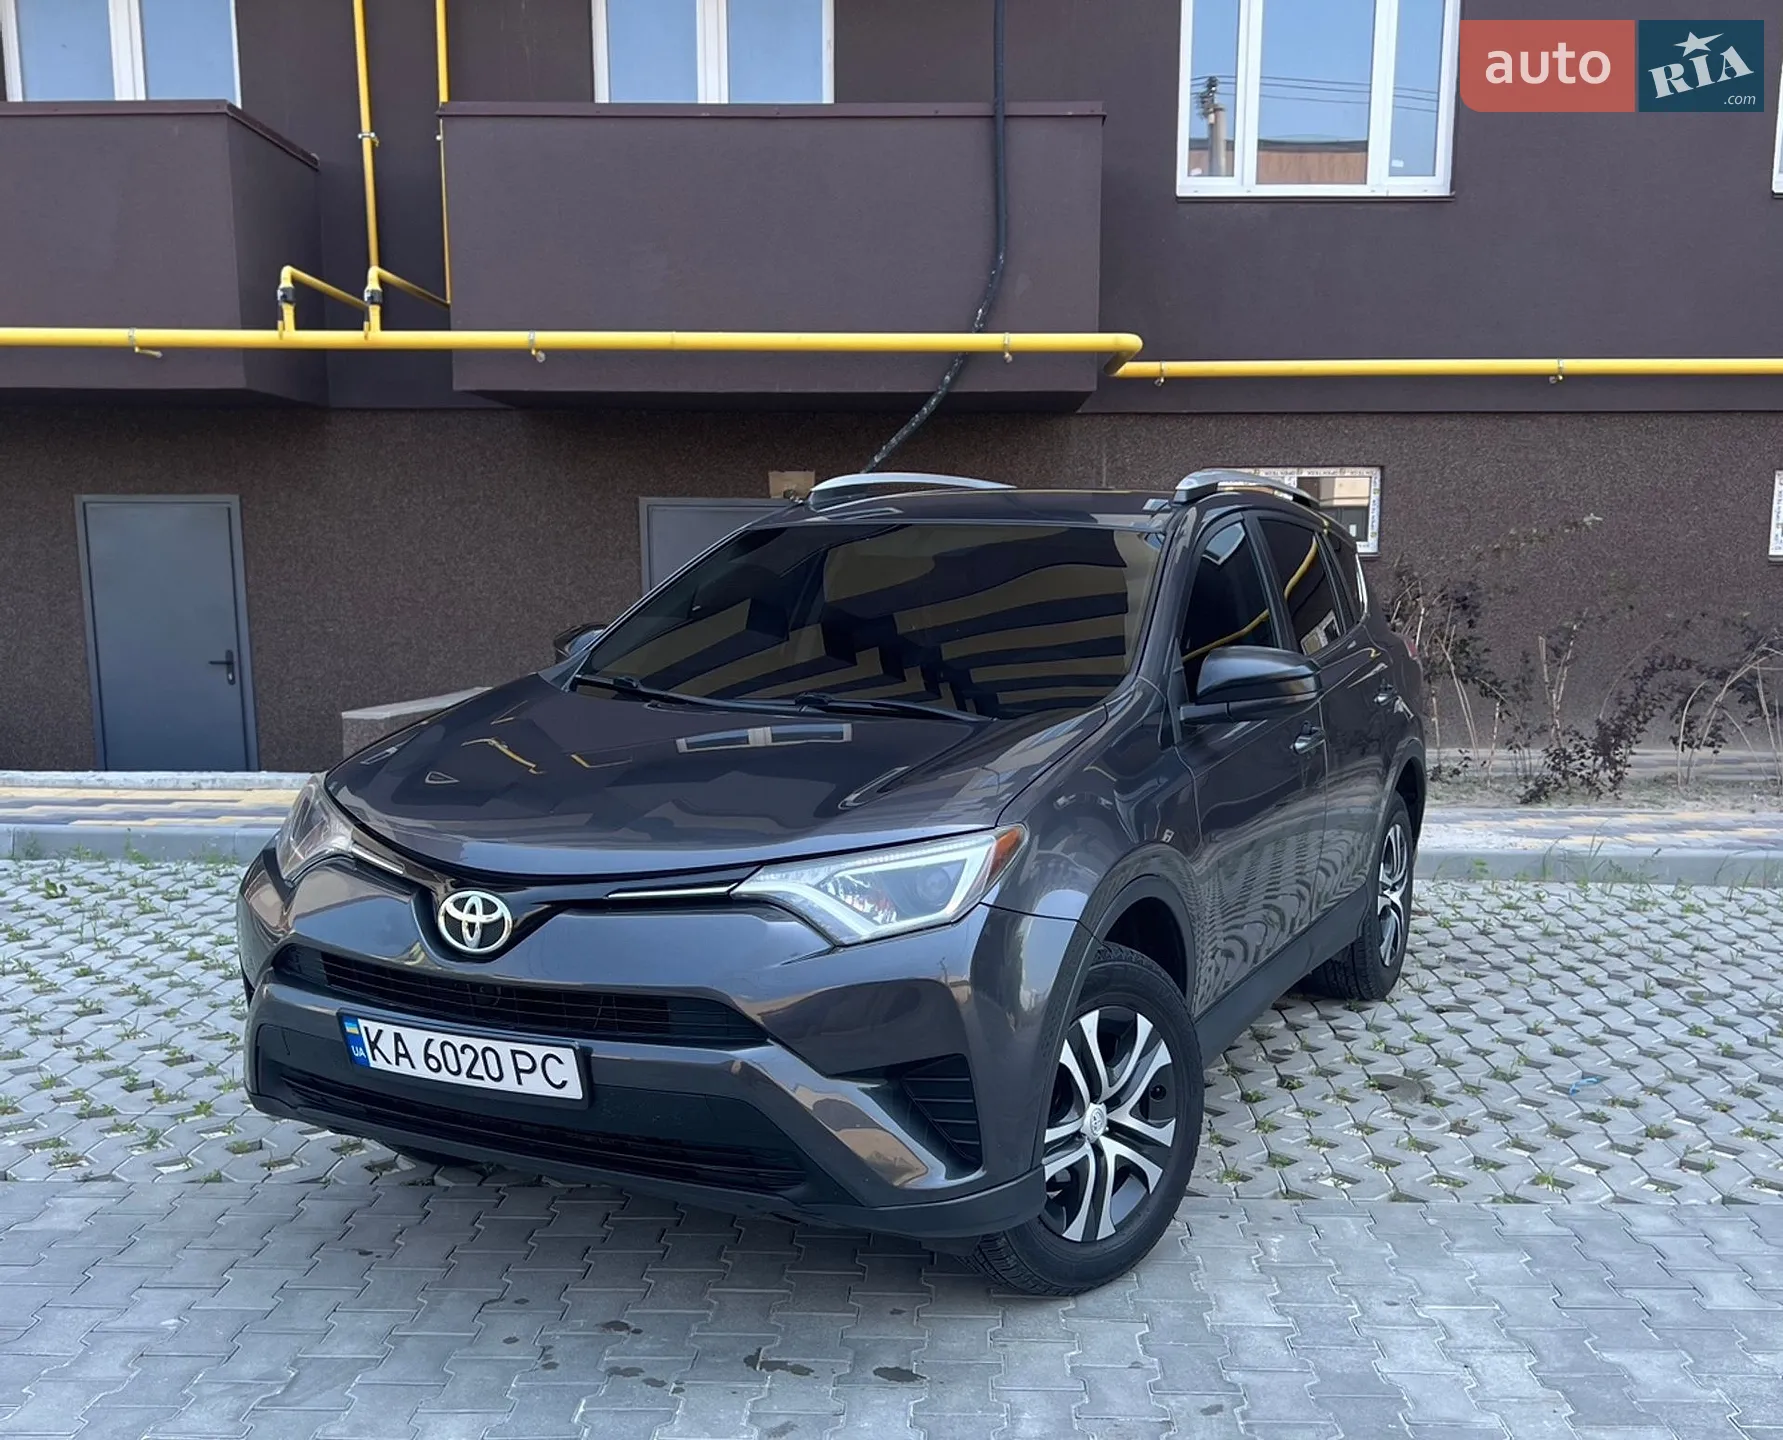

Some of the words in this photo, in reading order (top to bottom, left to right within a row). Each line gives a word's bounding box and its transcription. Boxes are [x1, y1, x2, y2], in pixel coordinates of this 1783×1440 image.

[351, 1045, 367, 1059] UA
[363, 1026, 416, 1069] KA
[423, 1038, 504, 1083] 6020
[510, 1049, 568, 1089] PC
